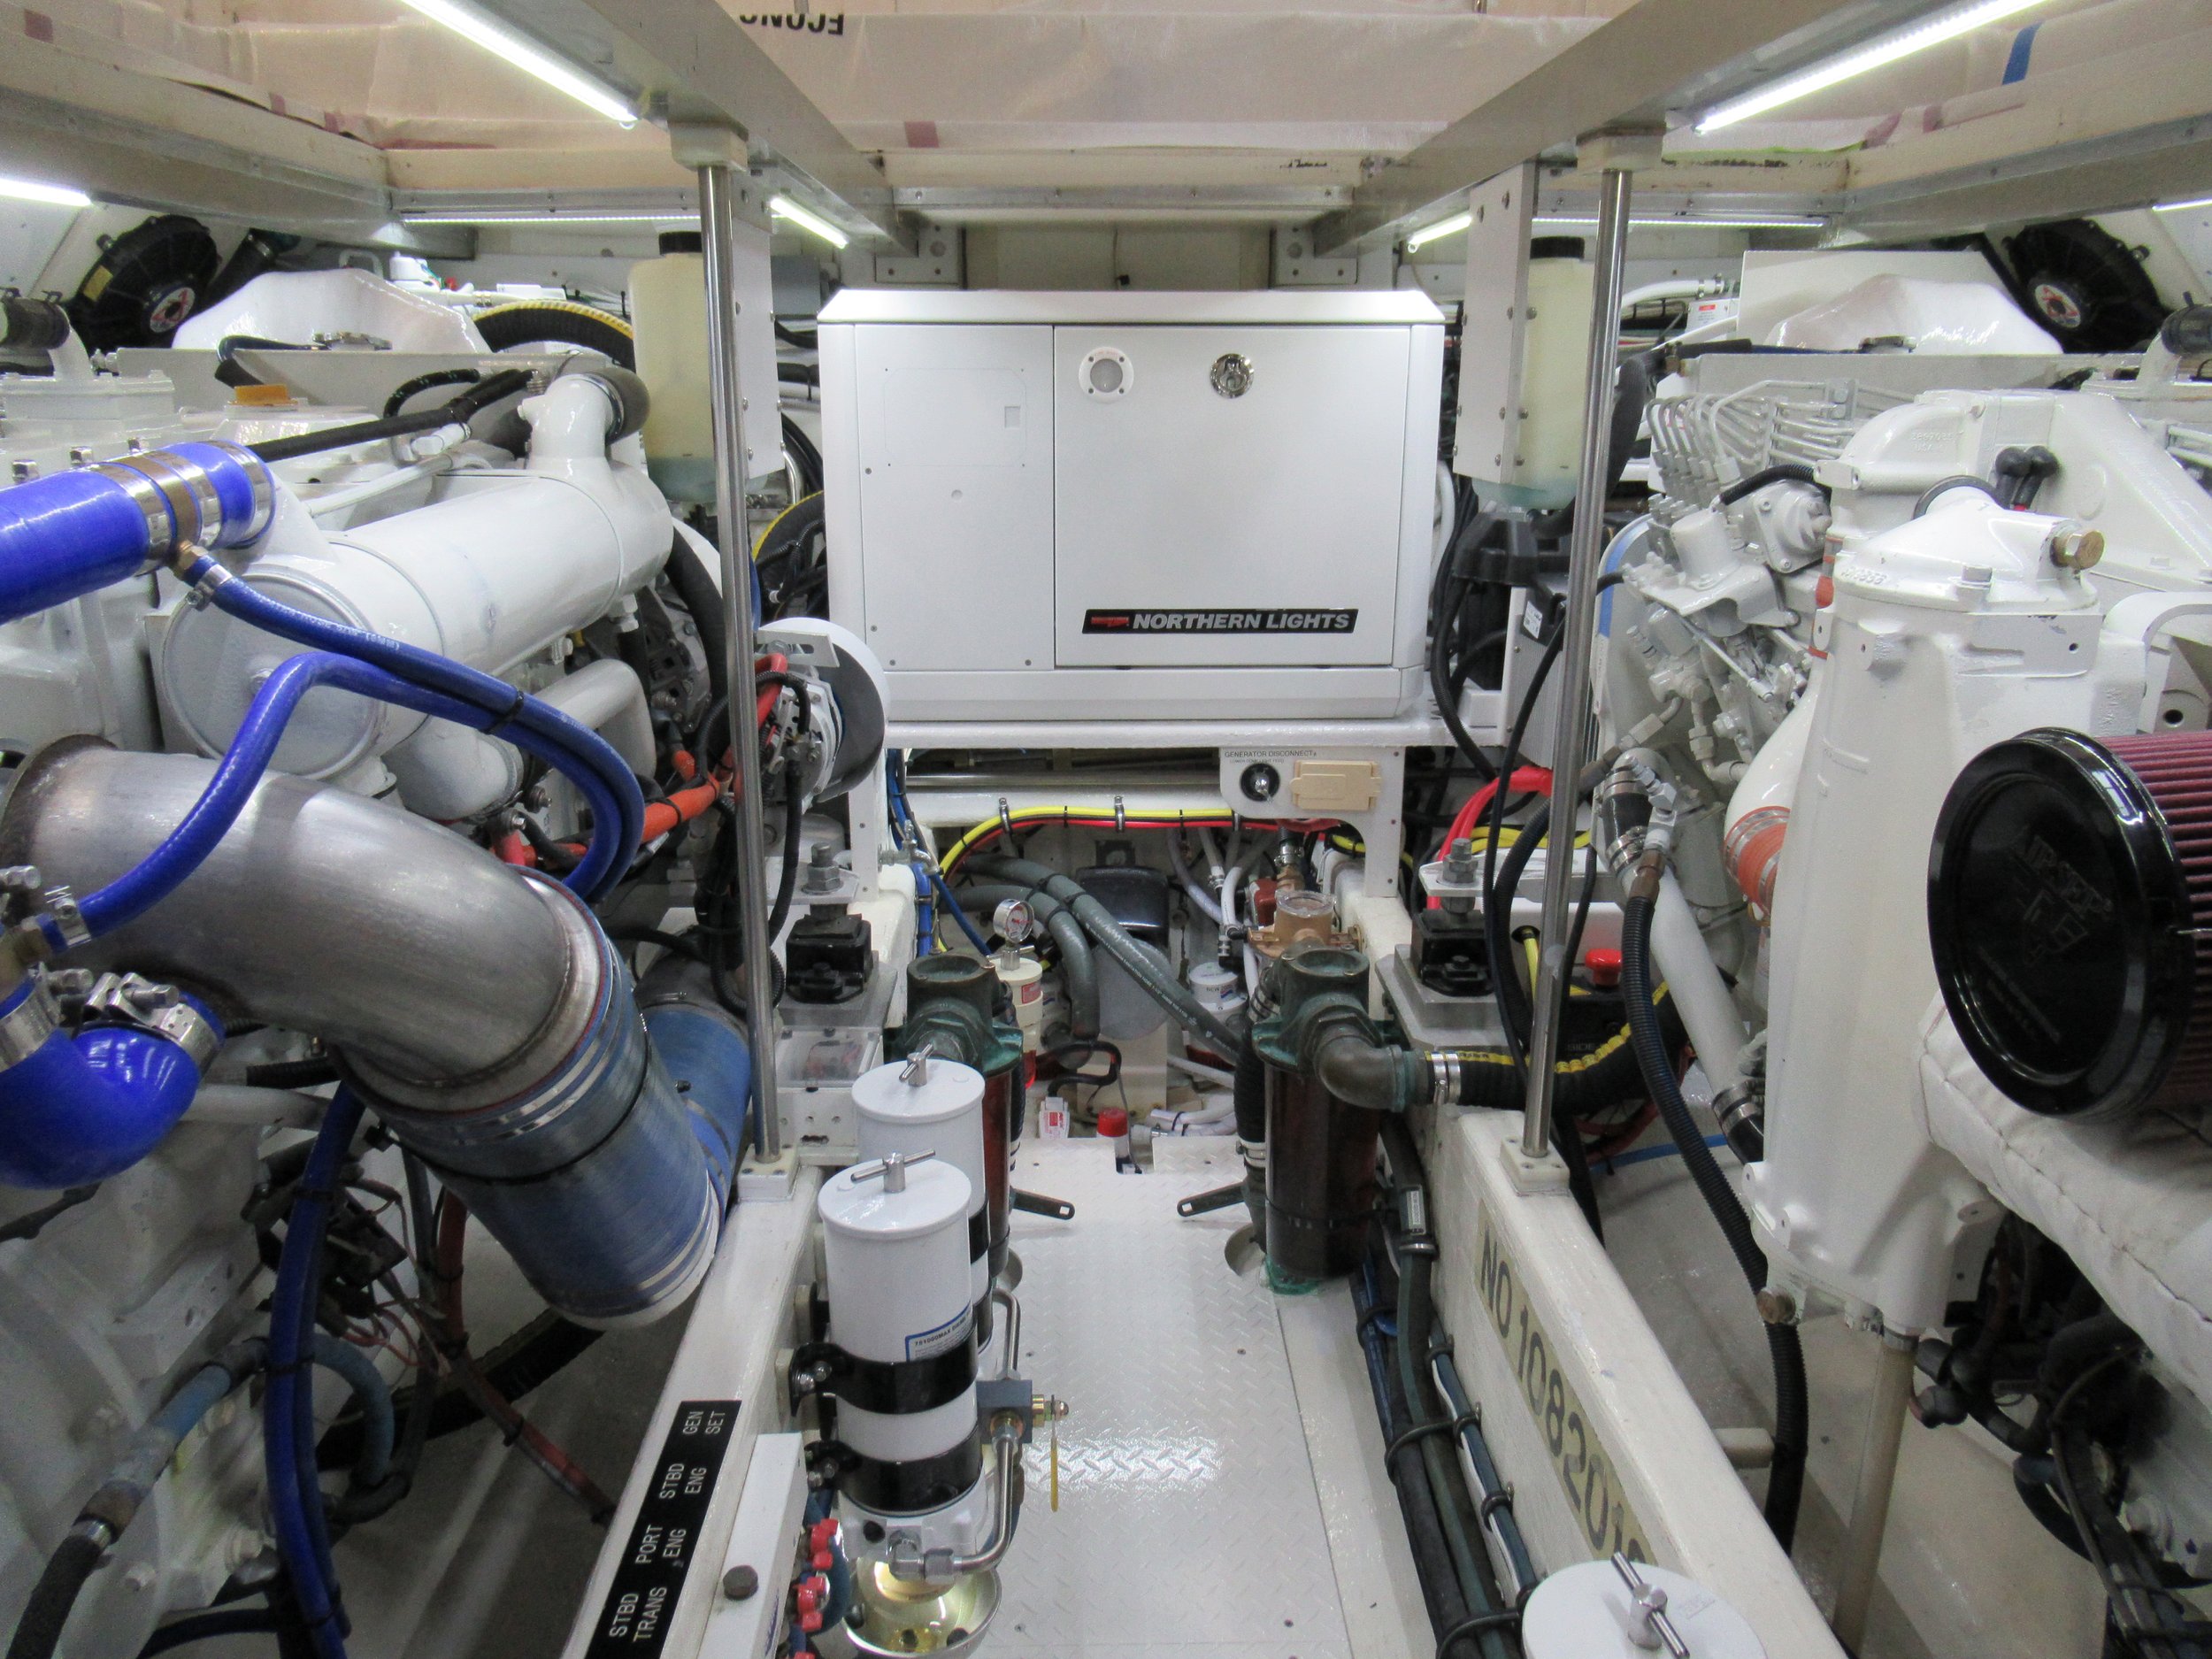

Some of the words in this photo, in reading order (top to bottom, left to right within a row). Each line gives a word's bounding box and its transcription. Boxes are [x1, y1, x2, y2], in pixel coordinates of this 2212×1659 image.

[740, 13, 844, 35] ECO
[1133, 613, 1262, 629] NORTHERN
[1266, 613, 1350, 629] LIGHTS
[682, 1410, 703, 1434] GEN
[704, 1410, 726, 1434] SET
[1517, 1304, 1646, 1563] 108201
[659, 1463, 684, 1499] STBD
[684, 1466, 707, 1494] ENG
[635, 1525, 663, 1564] PORT
[663, 1528, 687, 1558] ENG
[609, 1593, 639, 1637] STBD
[633, 1586, 667, 1643] TRANS
